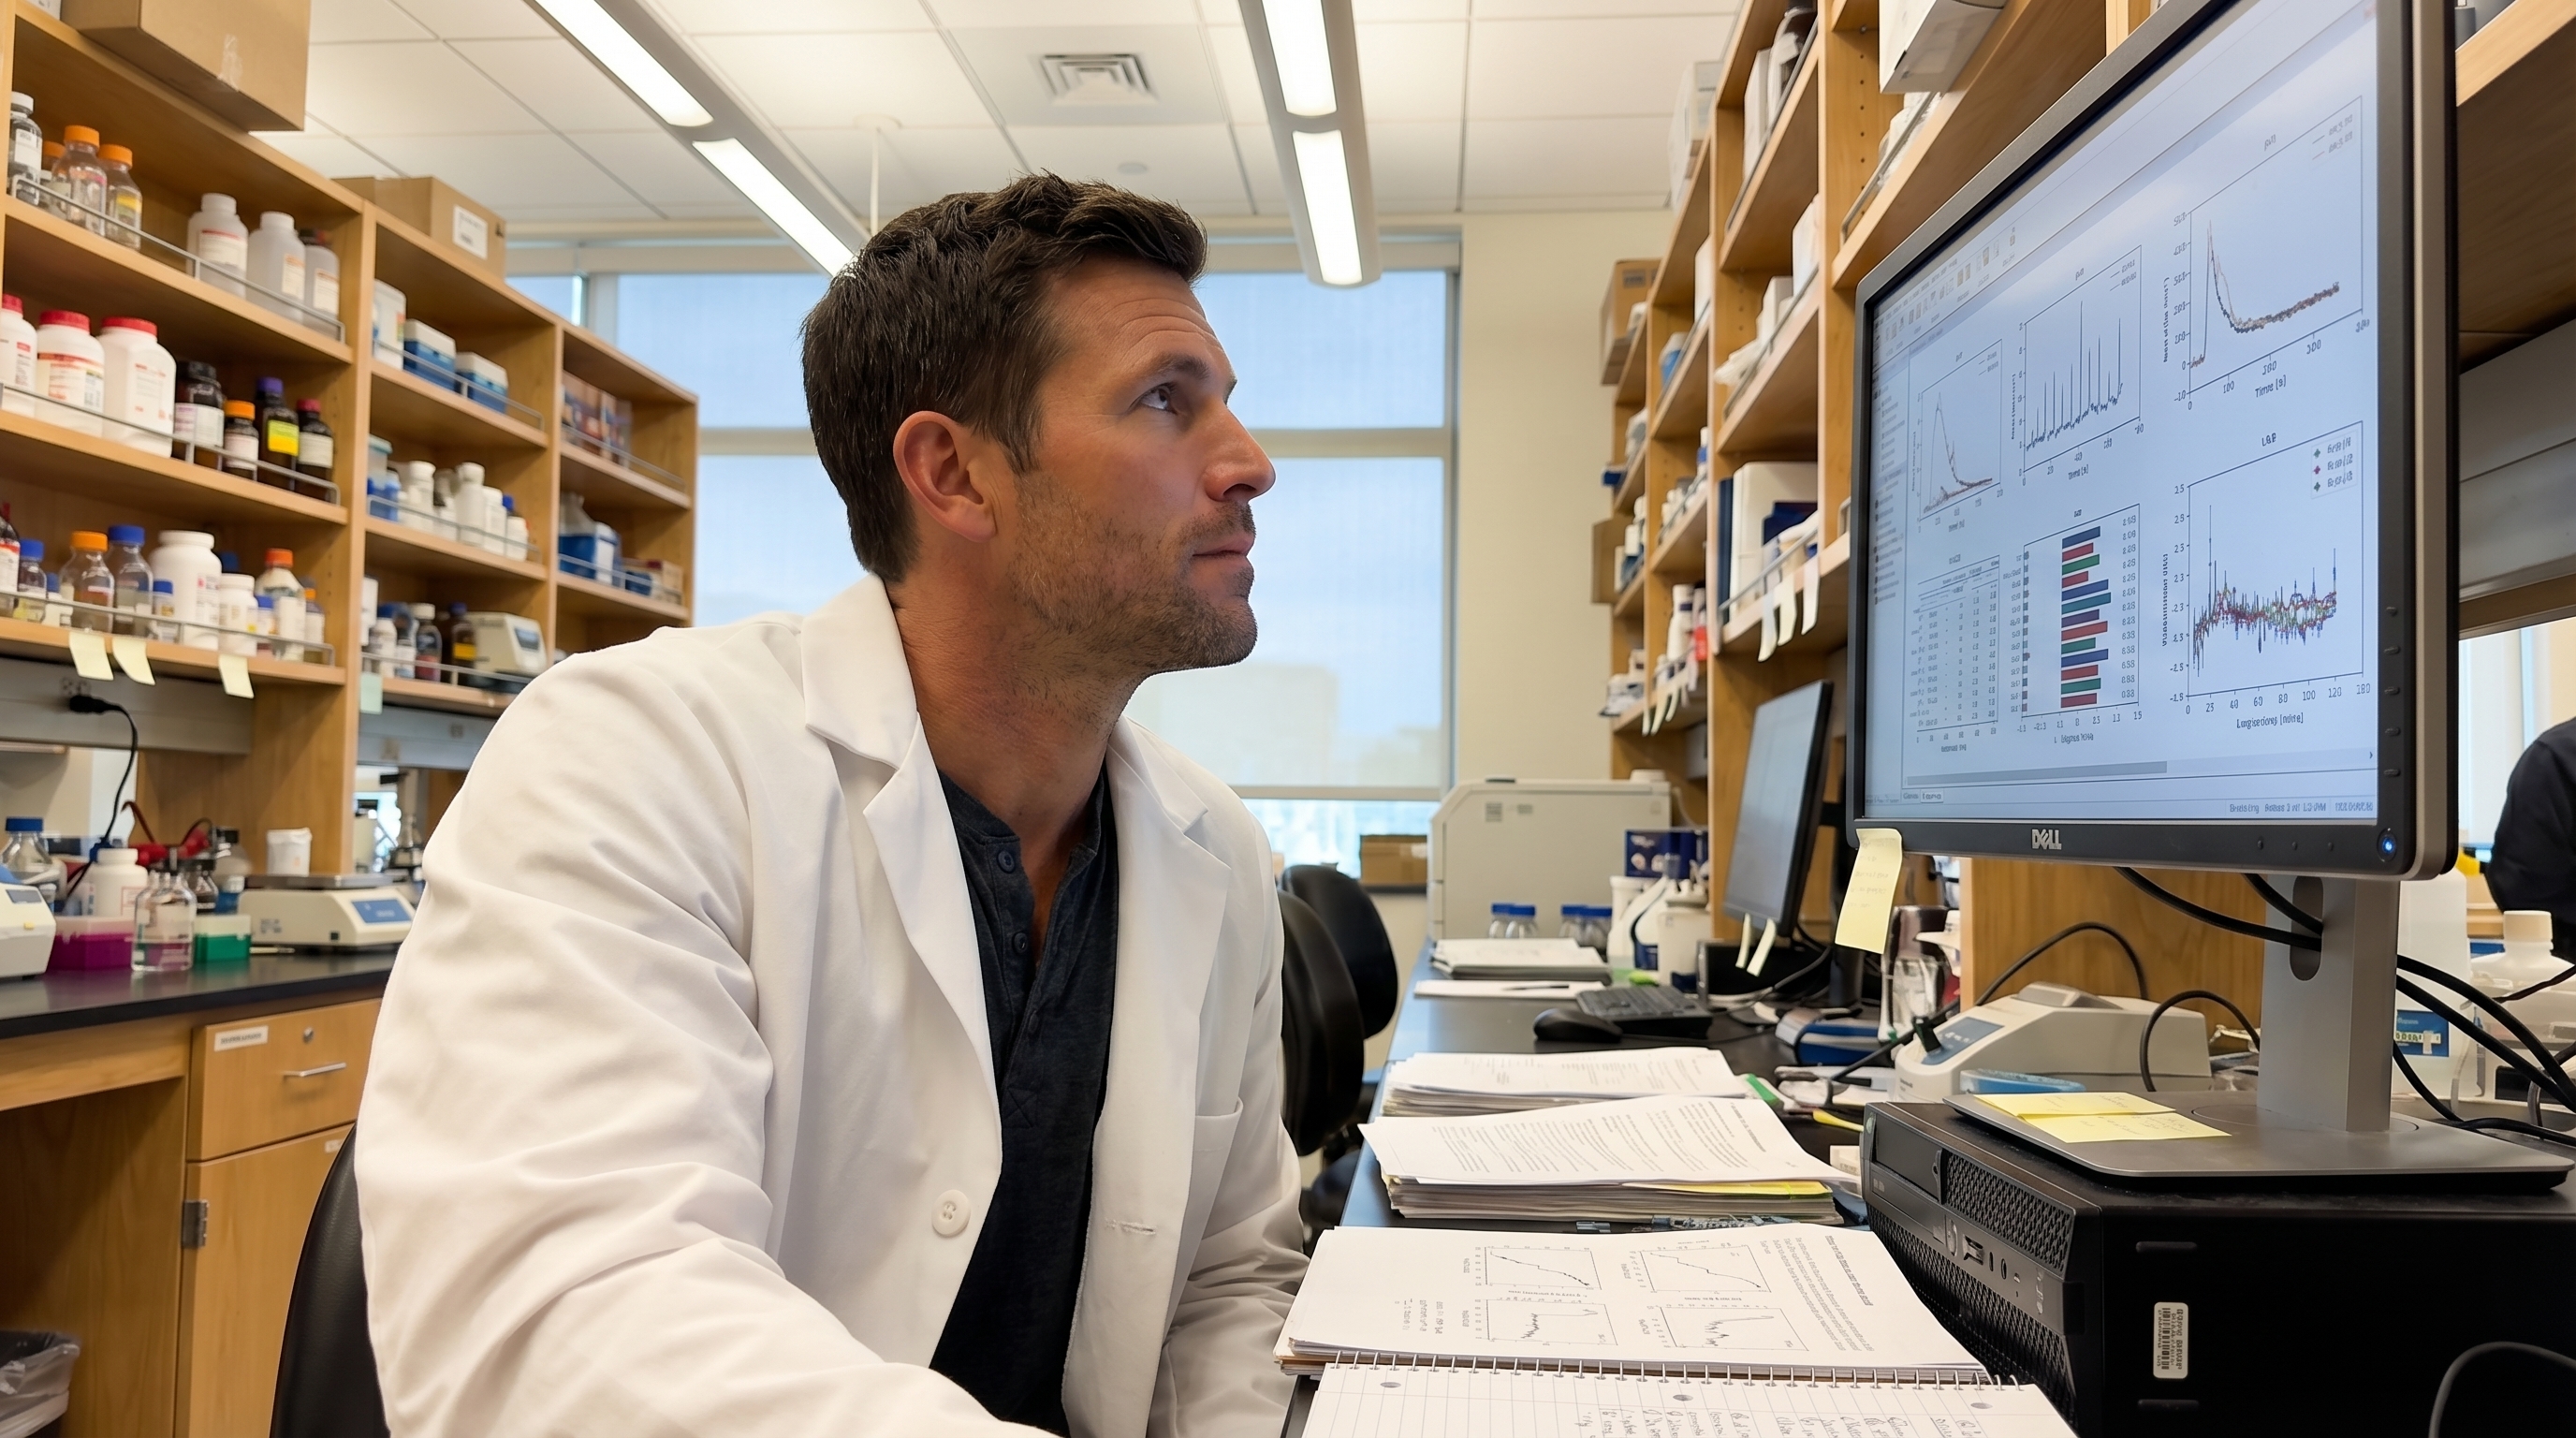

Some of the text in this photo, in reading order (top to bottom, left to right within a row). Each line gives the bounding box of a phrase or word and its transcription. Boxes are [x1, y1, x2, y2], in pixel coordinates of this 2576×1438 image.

[2186, 704, 2190, 714] 0
[2303, 690, 2316, 701] 100
[2031, 829, 2062, 850] DELL
